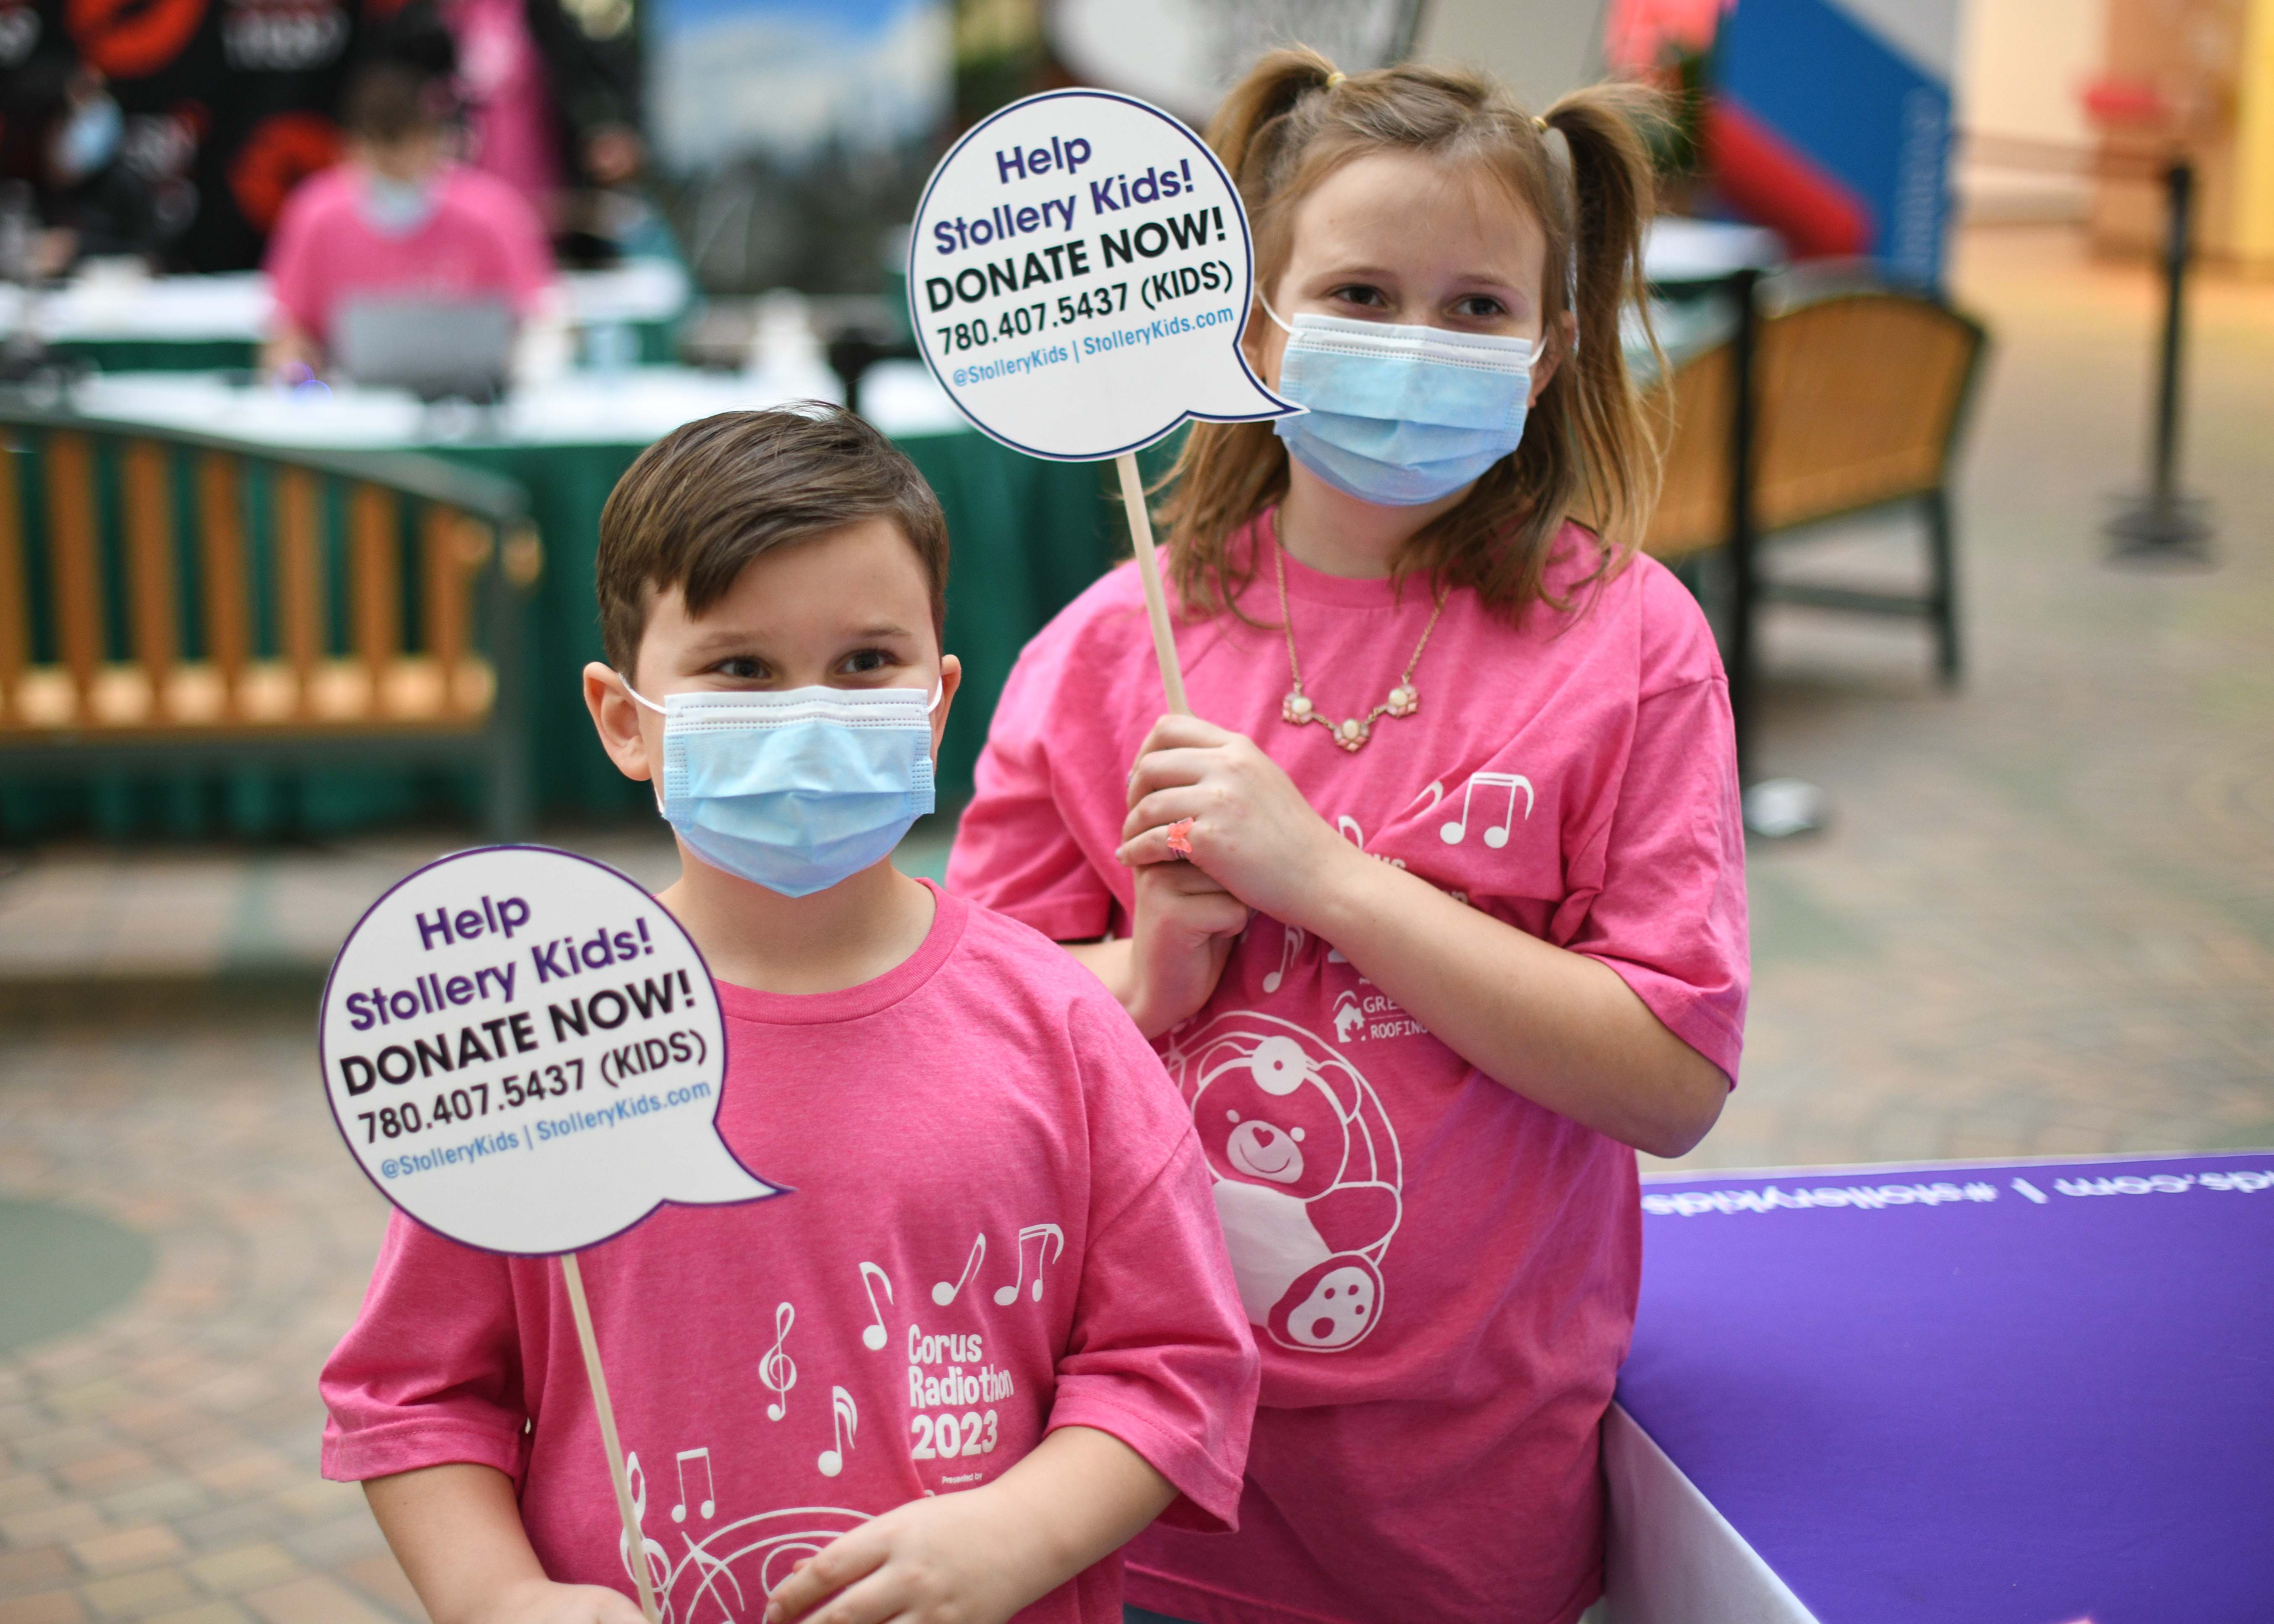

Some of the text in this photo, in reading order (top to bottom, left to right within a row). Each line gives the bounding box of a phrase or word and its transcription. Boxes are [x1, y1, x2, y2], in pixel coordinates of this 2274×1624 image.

[996, 136, 1092, 185] Help
[933, 158, 1194, 255] Stollery Kids!
[925, 205, 1226, 314] DONATE NOW!
[936, 259, 1234, 356] 780.407.5437 (KIDS)
[953, 346, 1069, 387] @StolleryKids
[1083, 308, 1234, 356] StolleryKids.com
[415, 895, 531, 952] Help
[345, 917, 654, 1031] Stollery Kids!
[339, 968, 696, 1097] DONATE NOW!
[357, 1029, 707, 1144] 780.407.5437 (KIDS)
[381, 1132, 519, 1179] @StolleryKids
[536, 1082, 710, 1141] StolleryKids.com
[908, 1323, 982, 1364] Corus
[908, 1363, 1014, 1408] Radiothon
[912, 1410, 998, 1459] 2023
[942, 1473, 974, 1484] Presented
